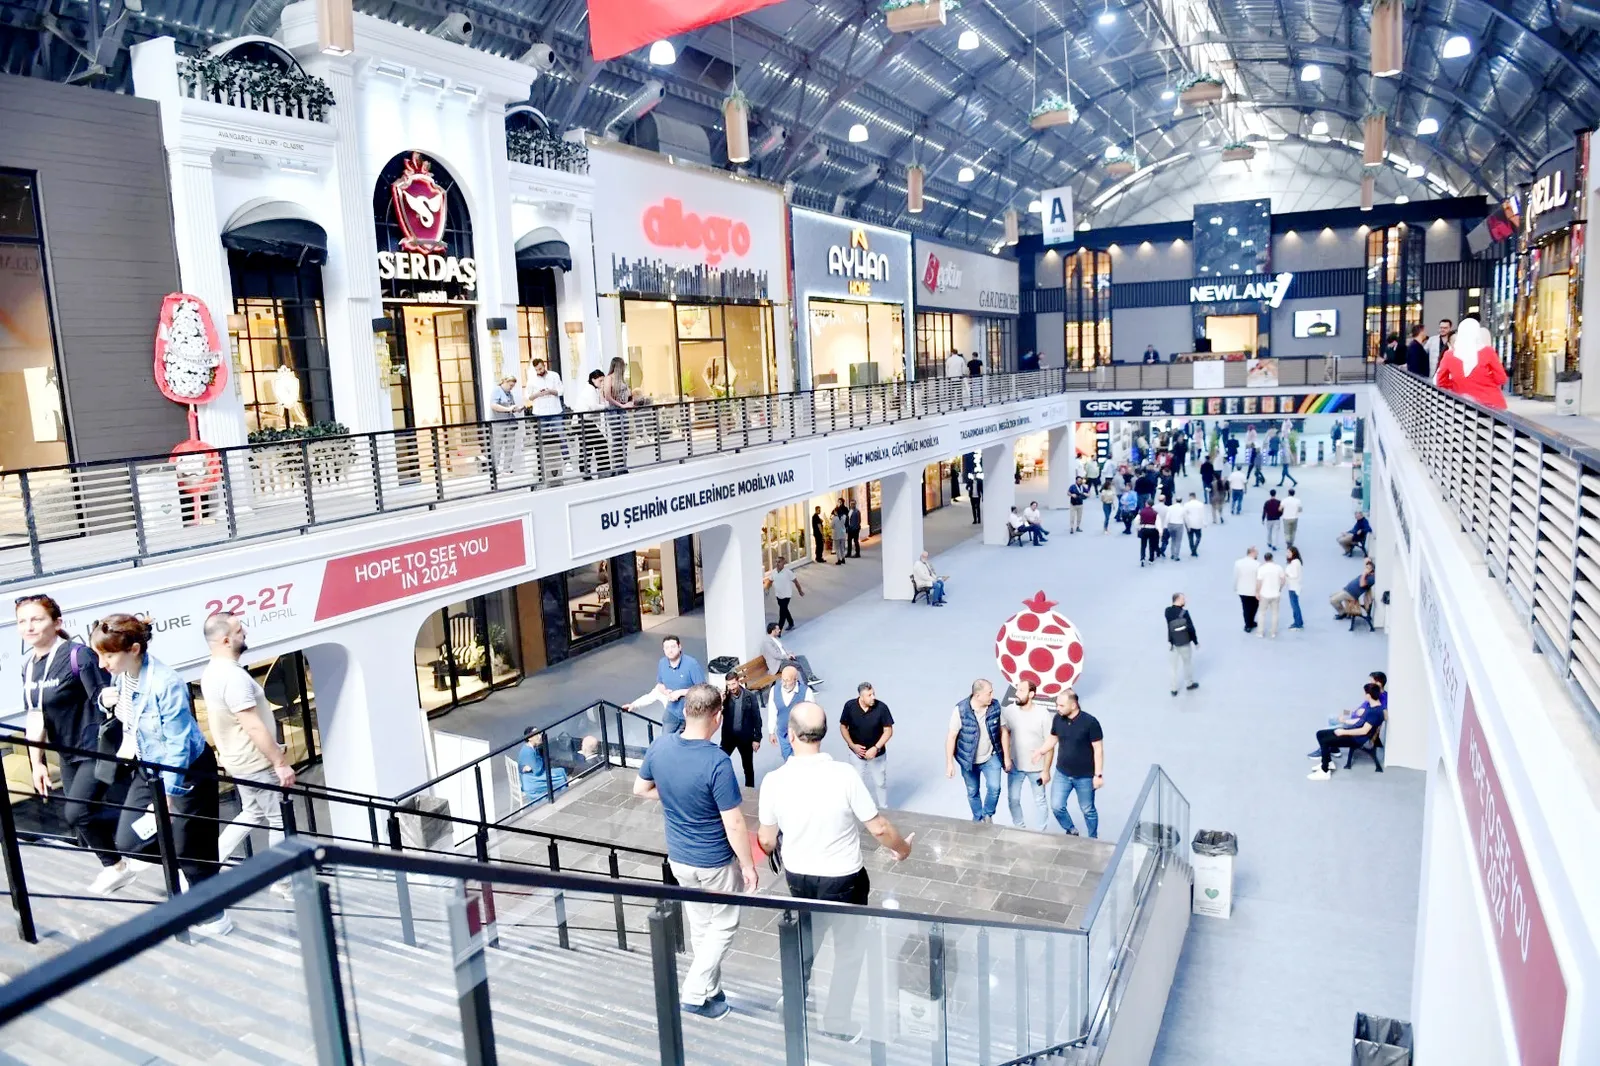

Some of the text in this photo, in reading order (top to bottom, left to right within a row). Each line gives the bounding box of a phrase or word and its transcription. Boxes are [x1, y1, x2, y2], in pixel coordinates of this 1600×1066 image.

[1050, 196, 1067, 224] A
[377, 250, 477, 292] SERDAŞ
[828, 244, 889, 281] AYHAN
[848, 280, 871, 297] HOME
[979, 289, 1018, 311] GARDEROBE
[1190, 279, 1287, 303] NEWLAND
[1085, 400, 1133, 412] GENÇ
[845, 450, 864, 472] İŞİMİZ
[919, 434, 940, 450] MOBİLYA
[601, 469, 795, 530] BU ŞEHRİN GENLERİNDE MOBİLYA VAR
[355, 536, 490, 583] HOPE TO SEE YOU
[401, 562, 458, 590] IN 2024
[205, 583, 293, 616] 22-27
[260, 607, 297, 625] APRIL
[1469, 727, 1531, 965] HOPE TO SEE YOU
[1486, 843, 1507, 939] 2024
